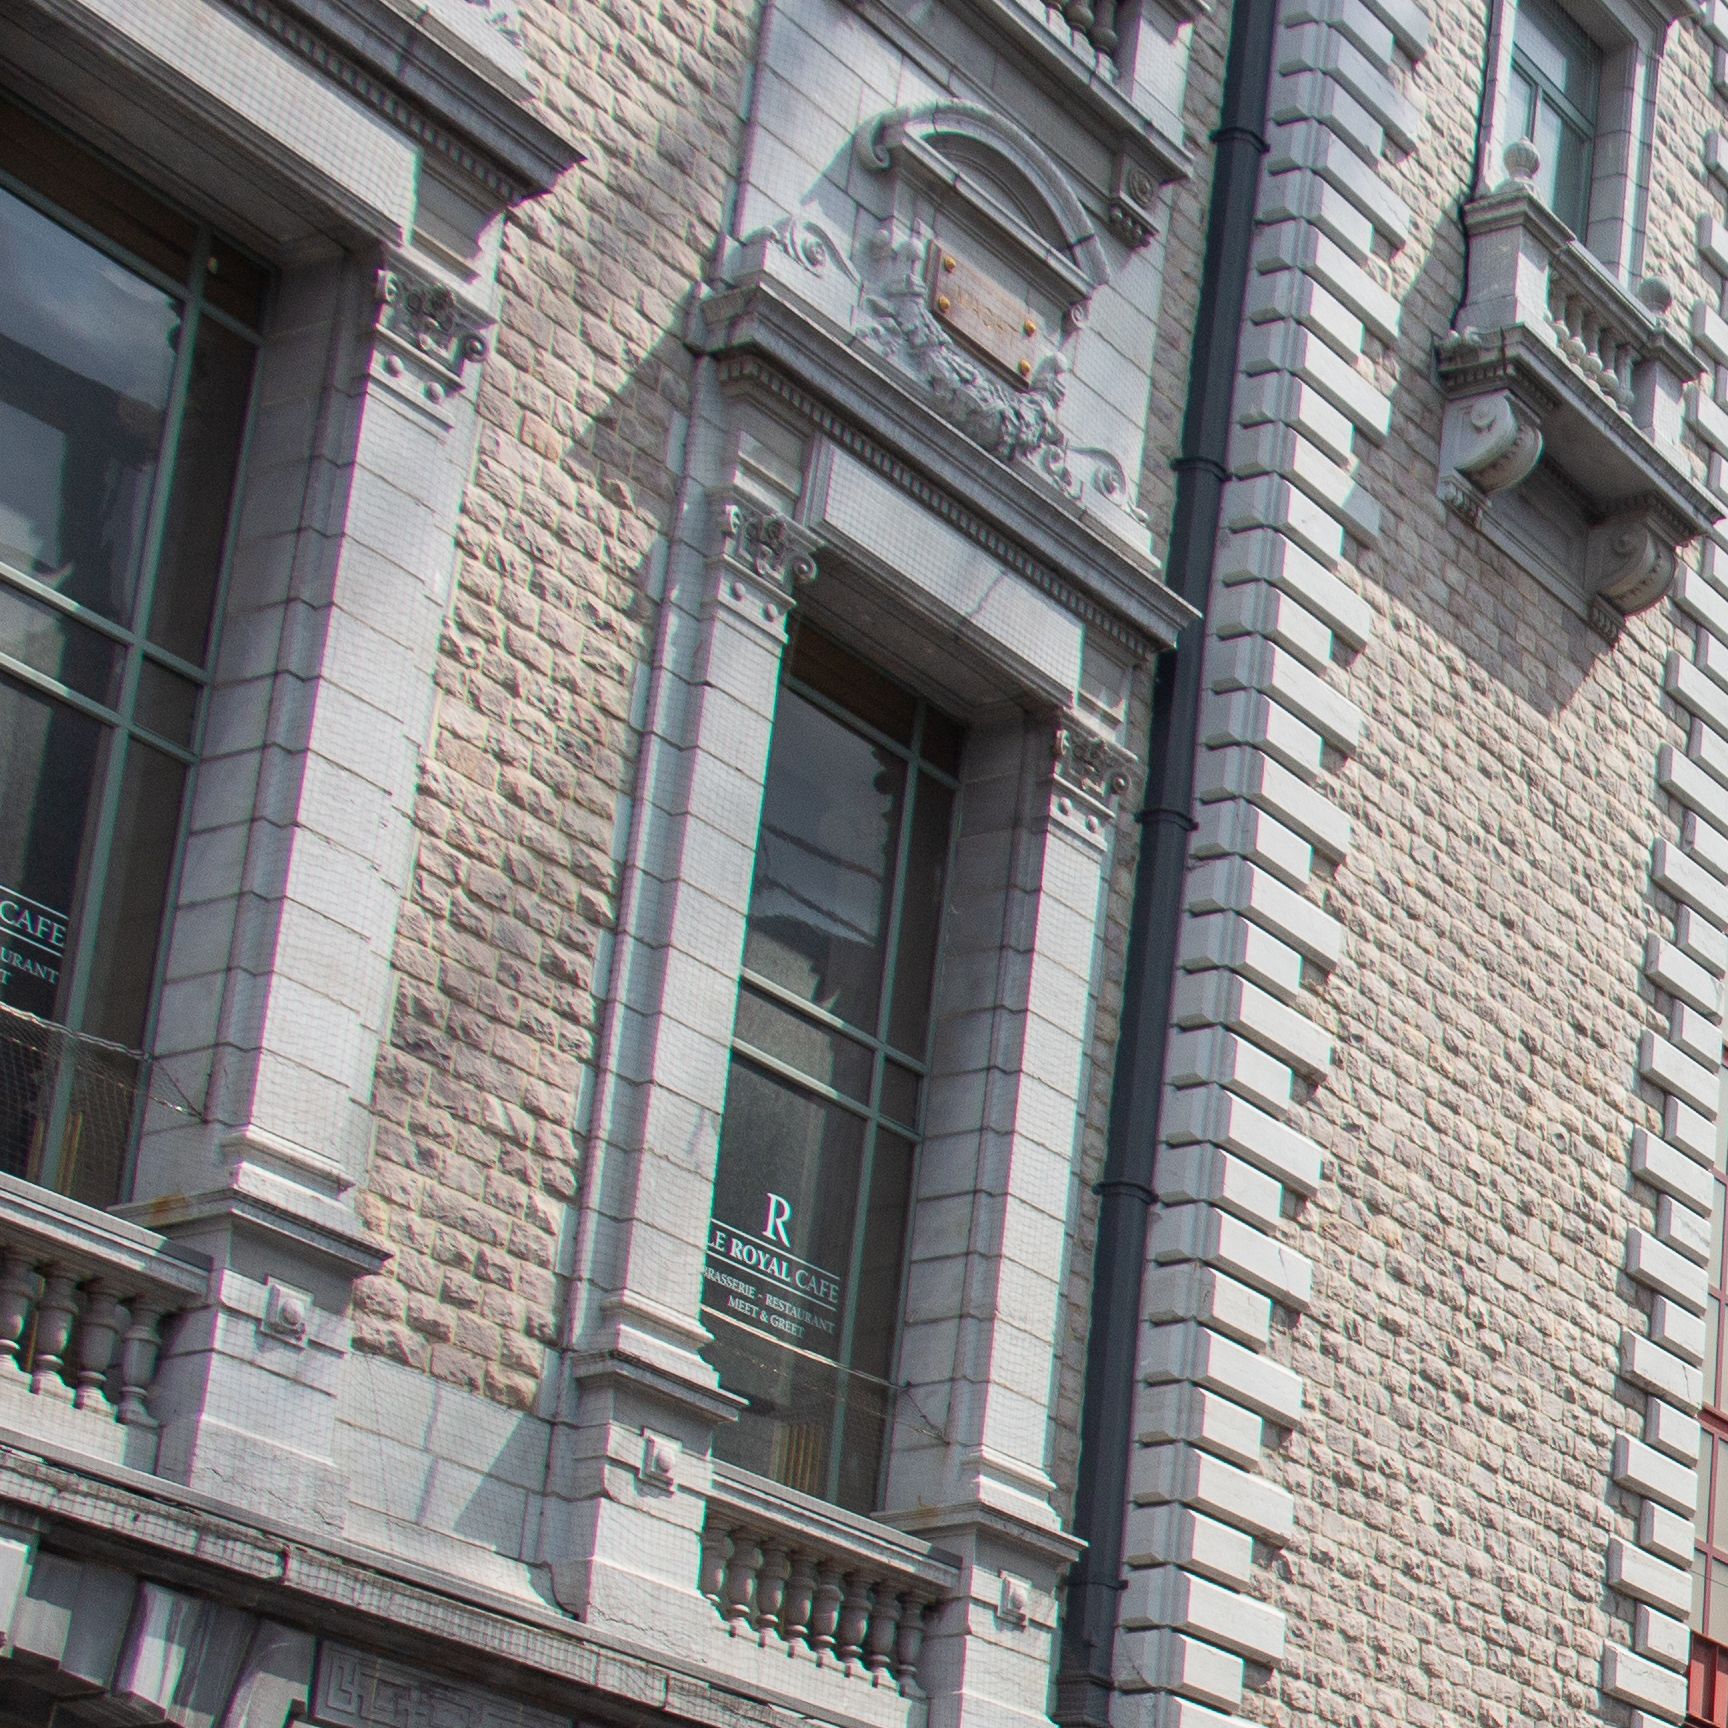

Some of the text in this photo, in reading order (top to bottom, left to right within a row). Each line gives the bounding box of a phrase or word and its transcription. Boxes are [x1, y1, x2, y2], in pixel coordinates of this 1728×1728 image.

[0, 900, 66, 947] CAFE
[761, 1192, 791, 1248] R
[730, 1238, 791, 1282] ROYAL
[795, 1269, 839, 1303] CAFE
[728, 1295, 805, 1338] MEET & GREET
[766, 1294, 835, 1334] RESTAURANT
